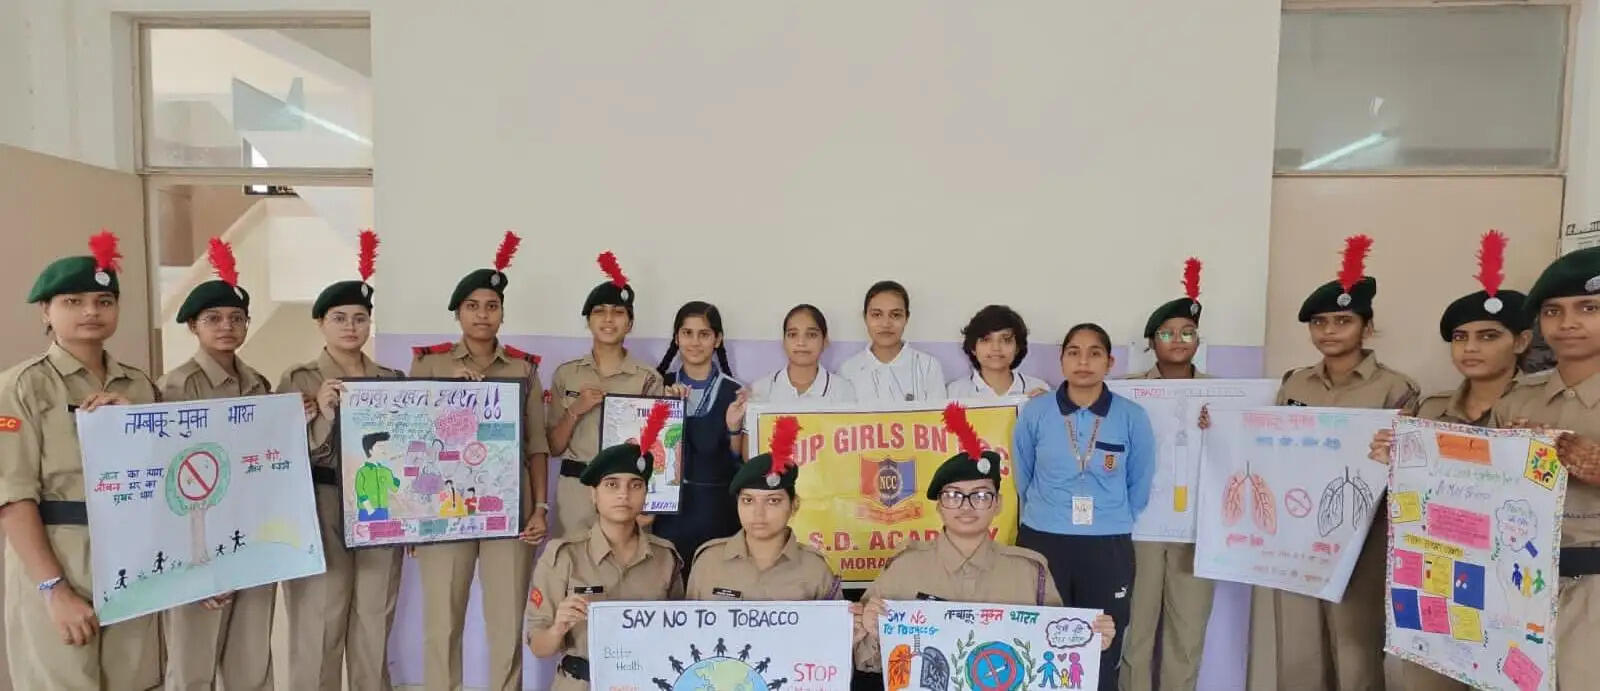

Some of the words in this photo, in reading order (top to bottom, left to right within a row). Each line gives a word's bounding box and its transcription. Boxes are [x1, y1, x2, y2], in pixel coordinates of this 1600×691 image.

[227, 404, 256, 424] भारत
[834, 423, 905, 454] GIRLS
[913, 423, 947, 453] BN
[879, 475, 897, 490] NCC
[622, 609, 656, 629] SAY
[663, 609, 687, 628] NO
[695, 609, 717, 628] TO
[887, 608, 906, 622] SAY
[910, 609, 928, 625] NO
[1009, 610, 1040, 624] भारत
[615, 659, 642, 671] Health
[793, 662, 837, 682] STOP
